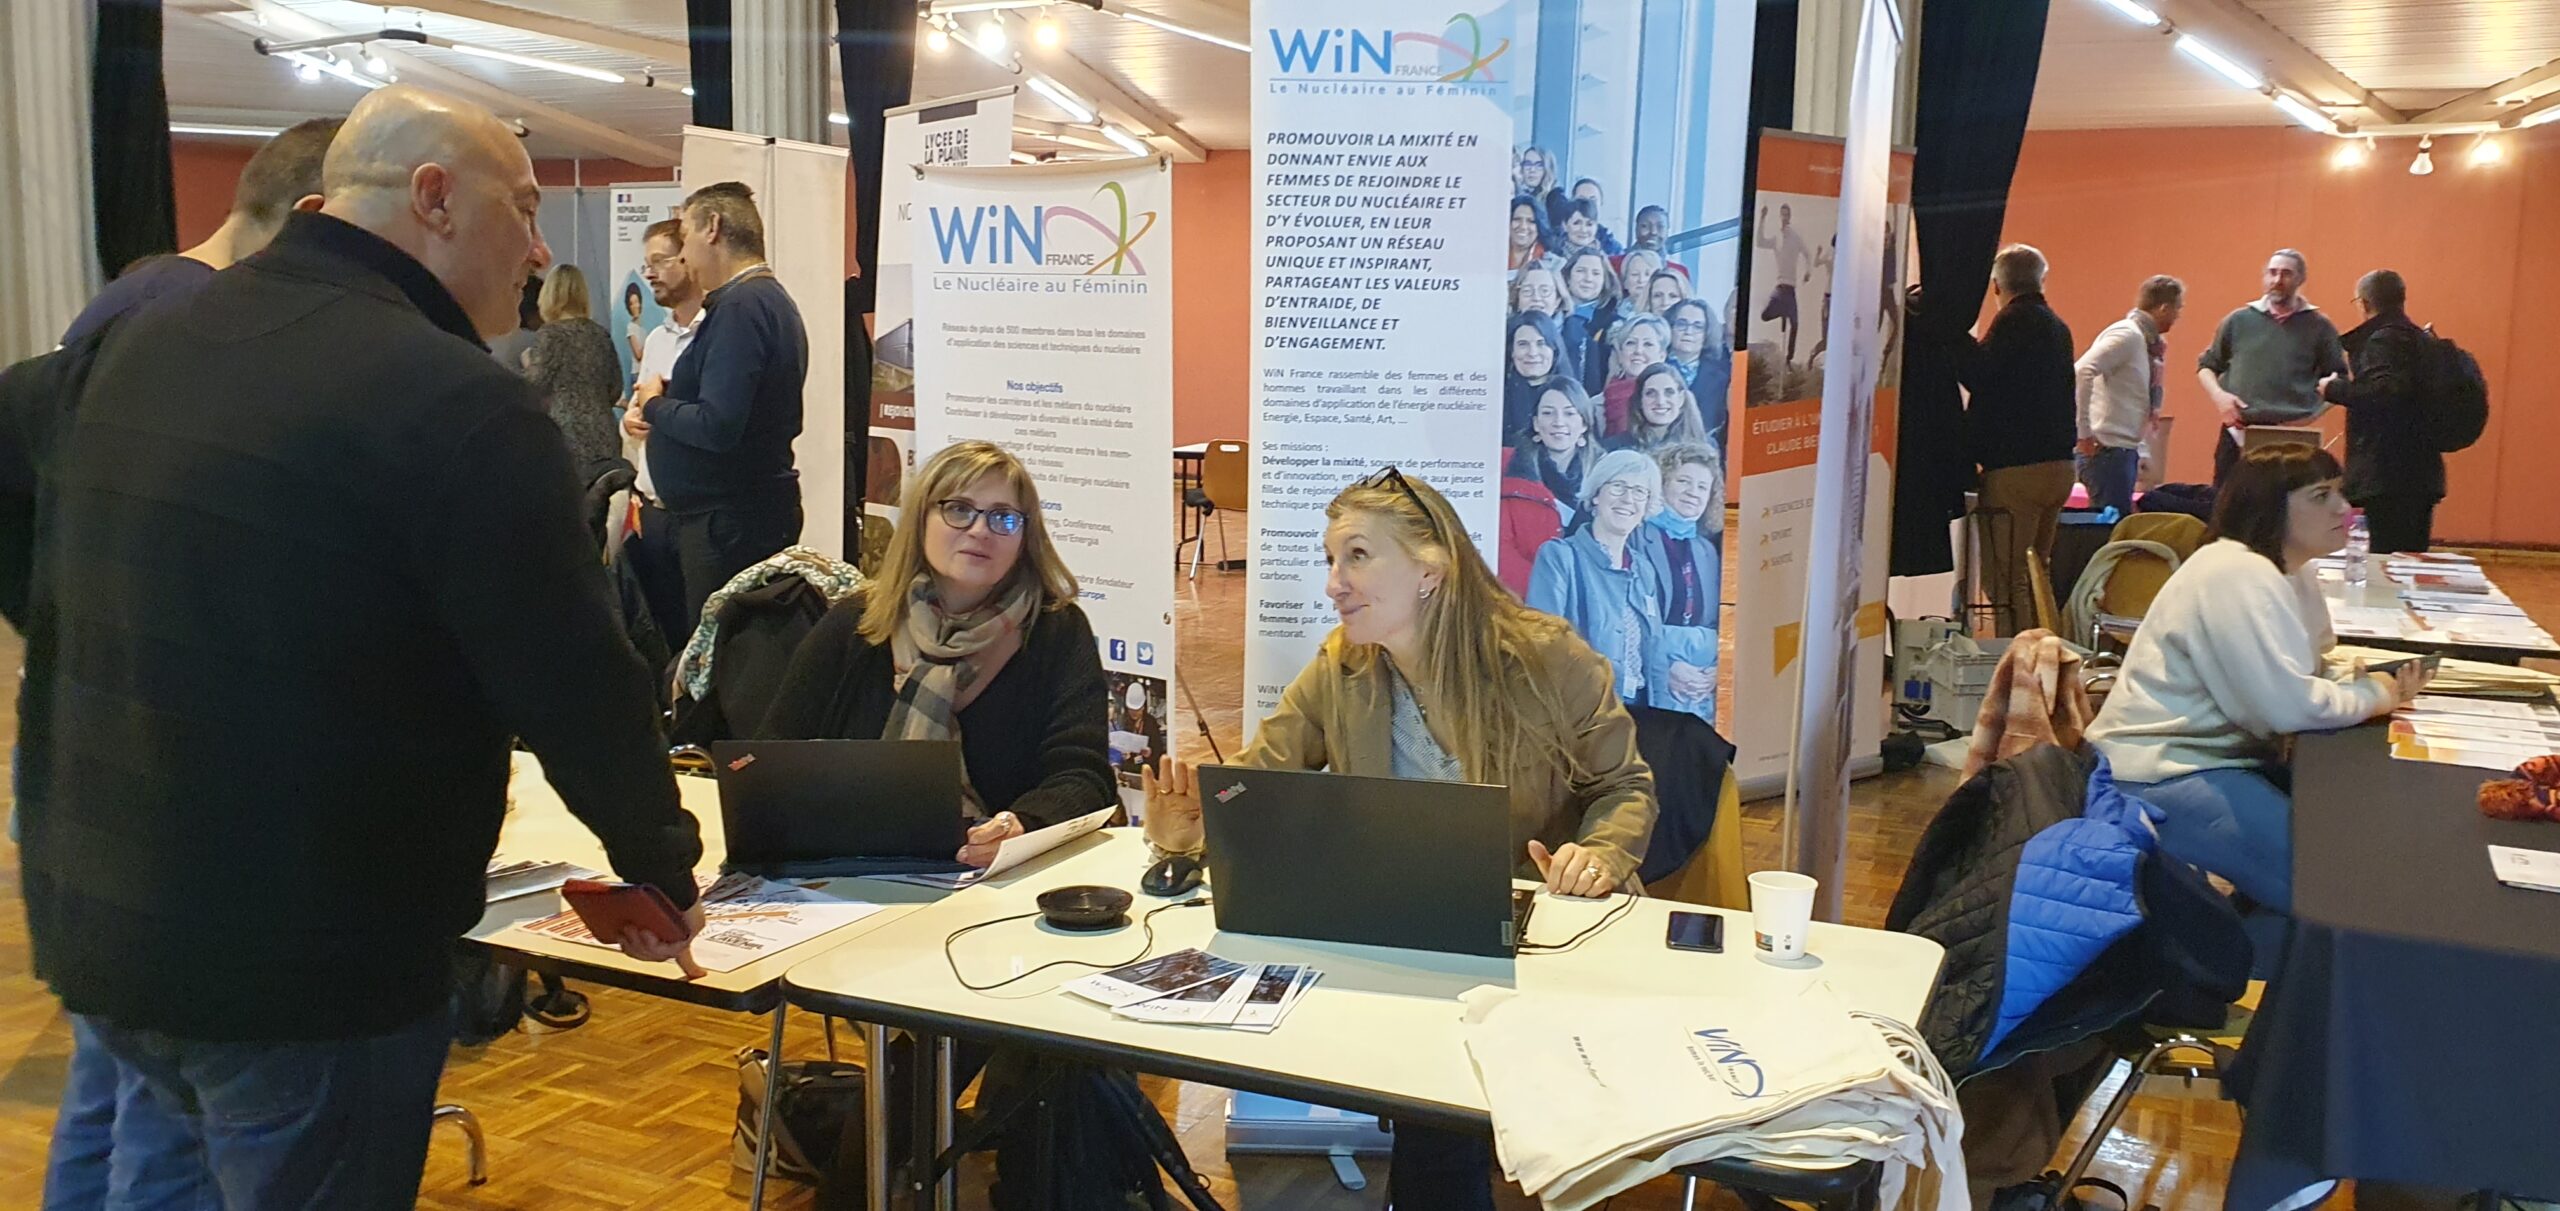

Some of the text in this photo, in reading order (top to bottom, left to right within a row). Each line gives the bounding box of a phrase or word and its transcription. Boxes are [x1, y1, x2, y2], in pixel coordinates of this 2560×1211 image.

[1269, 29, 1443, 76] WiN FRANCE
[1270, 83, 1497, 96] Le Nucléaire au Féminin
[956, 129, 968, 144] DE
[1267, 132, 1478, 147] PROMOUVOIR LA MIXITÉ EN
[925, 145, 968, 164] LA PLAINE
[1267, 153, 1428, 167] DONNANT ENVIE AUX
[1266, 174, 1462, 189] FEMMES DE REJOINDRE LE
[1266, 193, 1467, 209] SECTEUR DU NUCLÉAIRE ET
[1266, 212, 1432, 230] D'Y ÉVOLUER, EN LEUR
[929, 205, 1043, 265] WiN
[1045, 253, 1094, 266] FRANCE
[1265, 235, 1445, 250] PROPOSANT UN RÉSEAU
[1265, 256, 1432, 272] UNIQUE ET INSPIRANT,
[933, 276, 1148, 294] Le Nucléaire au Féminin
[1265, 276, 1460, 291] PARTAGEANT LES VALEURS
[1265, 296, 1382, 311] D'ENTRAIDE, DE
[1265, 316, 1399, 330] BIENVEILLANCE ET
[980, 325, 994, 335] plus
[995, 326, 1004, 334] de
[1057, 327, 1075, 337] dans
[1077, 328, 1093, 337] tous
[1095, 328, 1106, 338] les
[1107, 329, 1146, 339] domaines
[1050, 342, 1091, 354] techniques
[1265, 336, 1386, 350] D'ENGAGEMENT.
[1263, 369, 1487, 382] WiN France rassemble des femmes et des
[1007, 379, 1063, 394] Nos objectifs
[1263, 383, 1487, 396] hommes travaillant dans les différents
[1263, 398, 1310, 408] domaines
[1312, 398, 1376, 410] d'application
[1377, 399, 1391, 409] de
[1393, 399, 1436, 412] l'énergie
[1263, 412, 1396, 426] Energie, Espace, Santé, Art,
[1752, 417, 1792, 435] ÉTUDIER
[1262, 441, 1323, 452] Ses missions
[1766, 437, 1802, 455] CLAUDE
[1262, 456, 1320, 467] Développer
[1322, 456, 1331, 466] la
[1333, 456, 1368, 468] mixité,
[1405, 459, 1418, 468] de
[1420, 459, 1485, 470] performance
[1262, 471, 1272, 480] et
[1274, 471, 1338, 482] d'innovation,
[1341, 473, 1354, 481] en
[1430, 475, 1448, 483] aux
[1450, 474, 1484, 484] jeunes
[1262, 486, 1283, 495] filles
[1286, 486, 1300, 495] de
[1473, 489, 1484, 498] et
[1261, 499, 1310, 510] technique
[1260, 528, 1319, 538] Promouvoir
[1260, 543, 1309, 552] de toutes
[1260, 557, 1310, 568] particulier
[1260, 572, 1302, 582] carbone,
[1259, 599, 1304, 610] Favoriser
[1314, 600, 1323, 610] le
[1259, 614, 1338, 625] femmes par des
[1259, 629, 1306, 638] mentorat.
[1257, 684, 1278, 695] WiN
